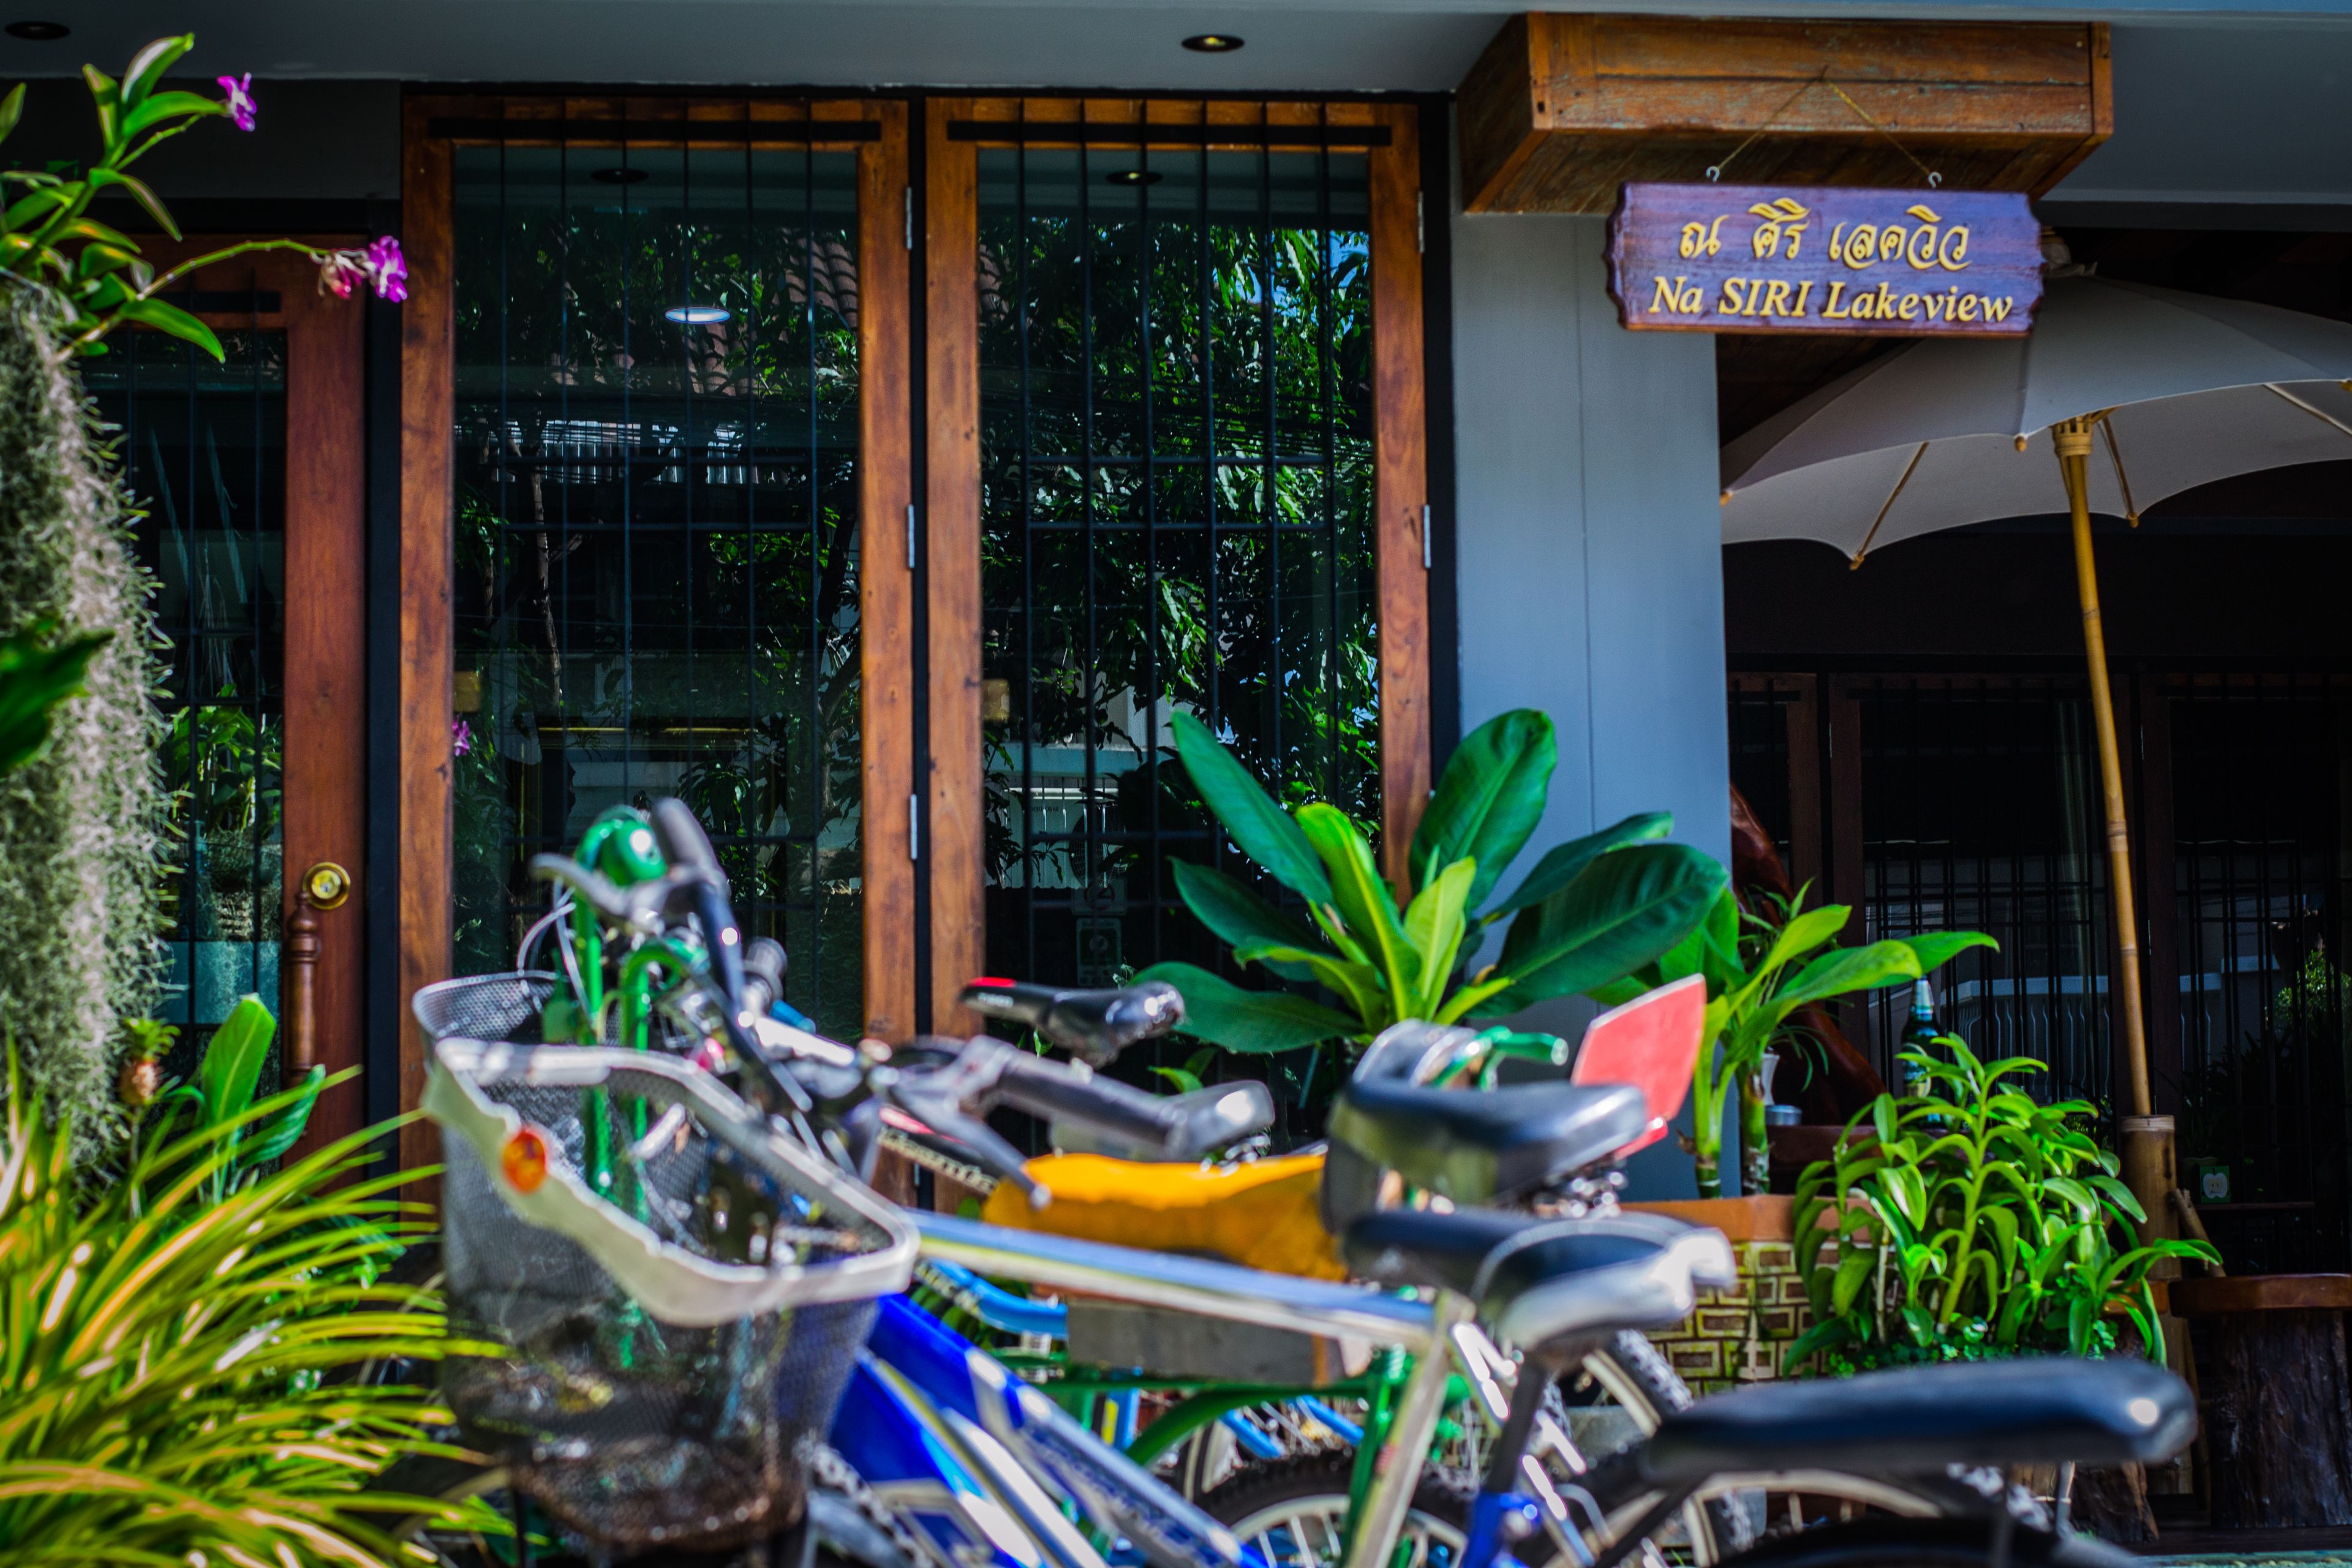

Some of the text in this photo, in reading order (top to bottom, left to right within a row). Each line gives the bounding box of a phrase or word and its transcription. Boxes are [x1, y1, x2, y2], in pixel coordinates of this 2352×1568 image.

[1679, 198, 1969, 270] ณ ศิริ เลควิว
[1646, 277, 2011, 322] Na SIRI Lakeview
